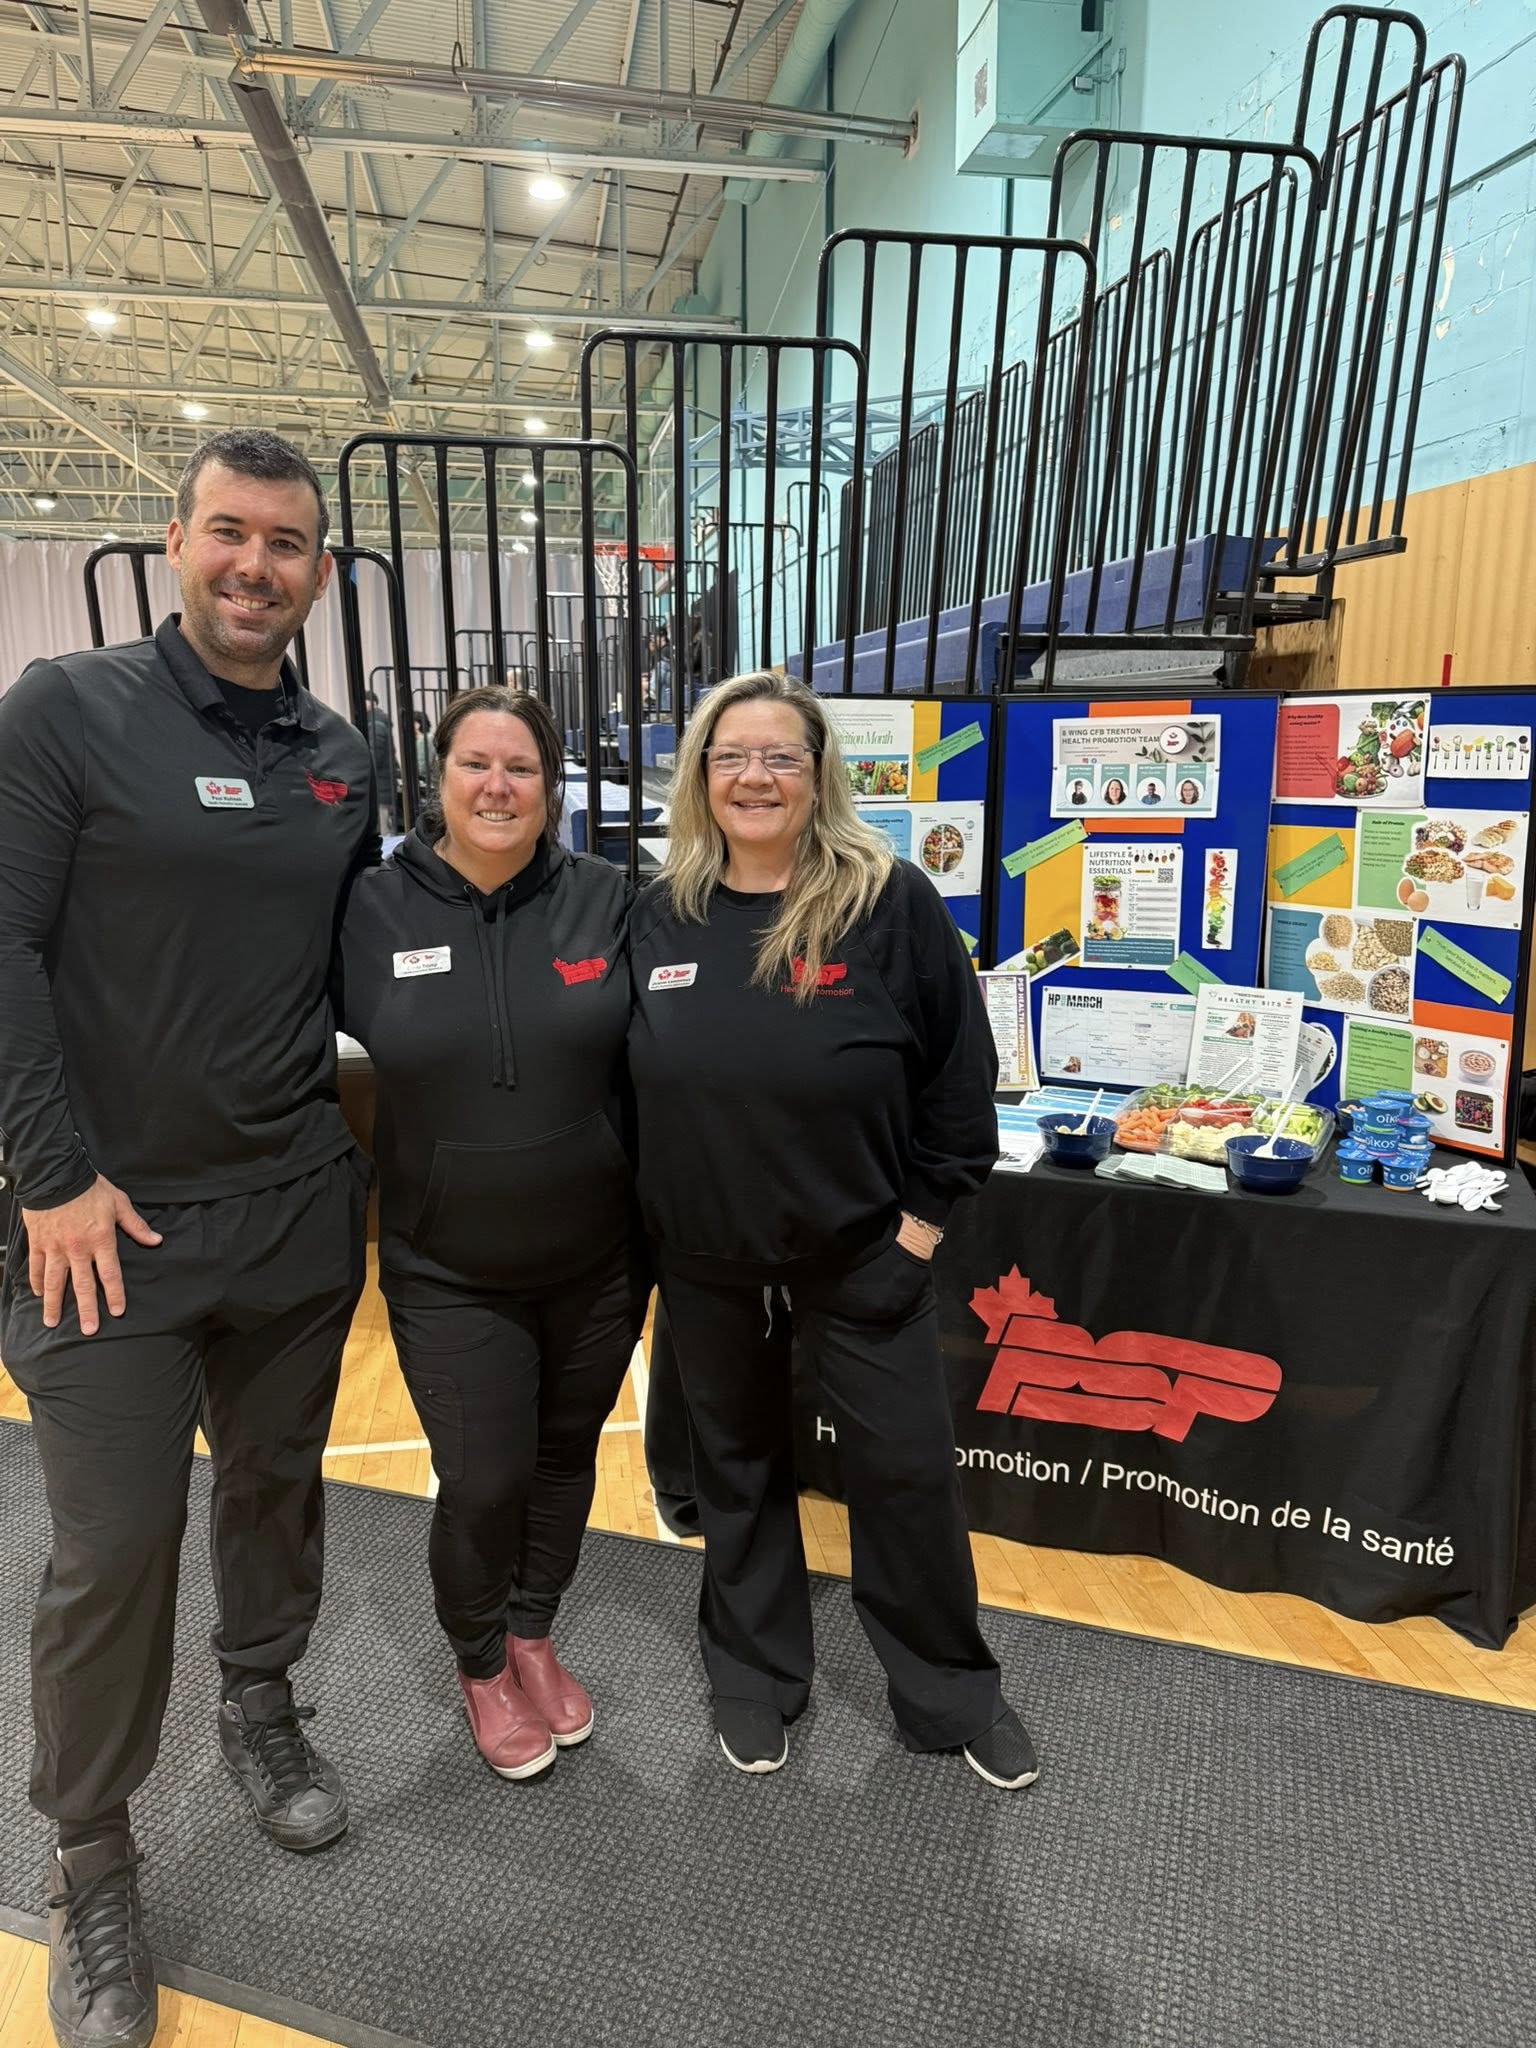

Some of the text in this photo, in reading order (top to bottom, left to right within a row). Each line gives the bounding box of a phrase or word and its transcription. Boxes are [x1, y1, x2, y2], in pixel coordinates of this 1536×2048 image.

[838, 730, 893, 745] trition Month
[815, 986, 854, 997] romotion
[1048, 994, 1061, 1006] HP
[1067, 994, 1103, 1009] MARCH
[1218, 997, 1256, 1005] HEALTHY
[955, 1448, 1455, 1566] omotion / Promotion de la santé
